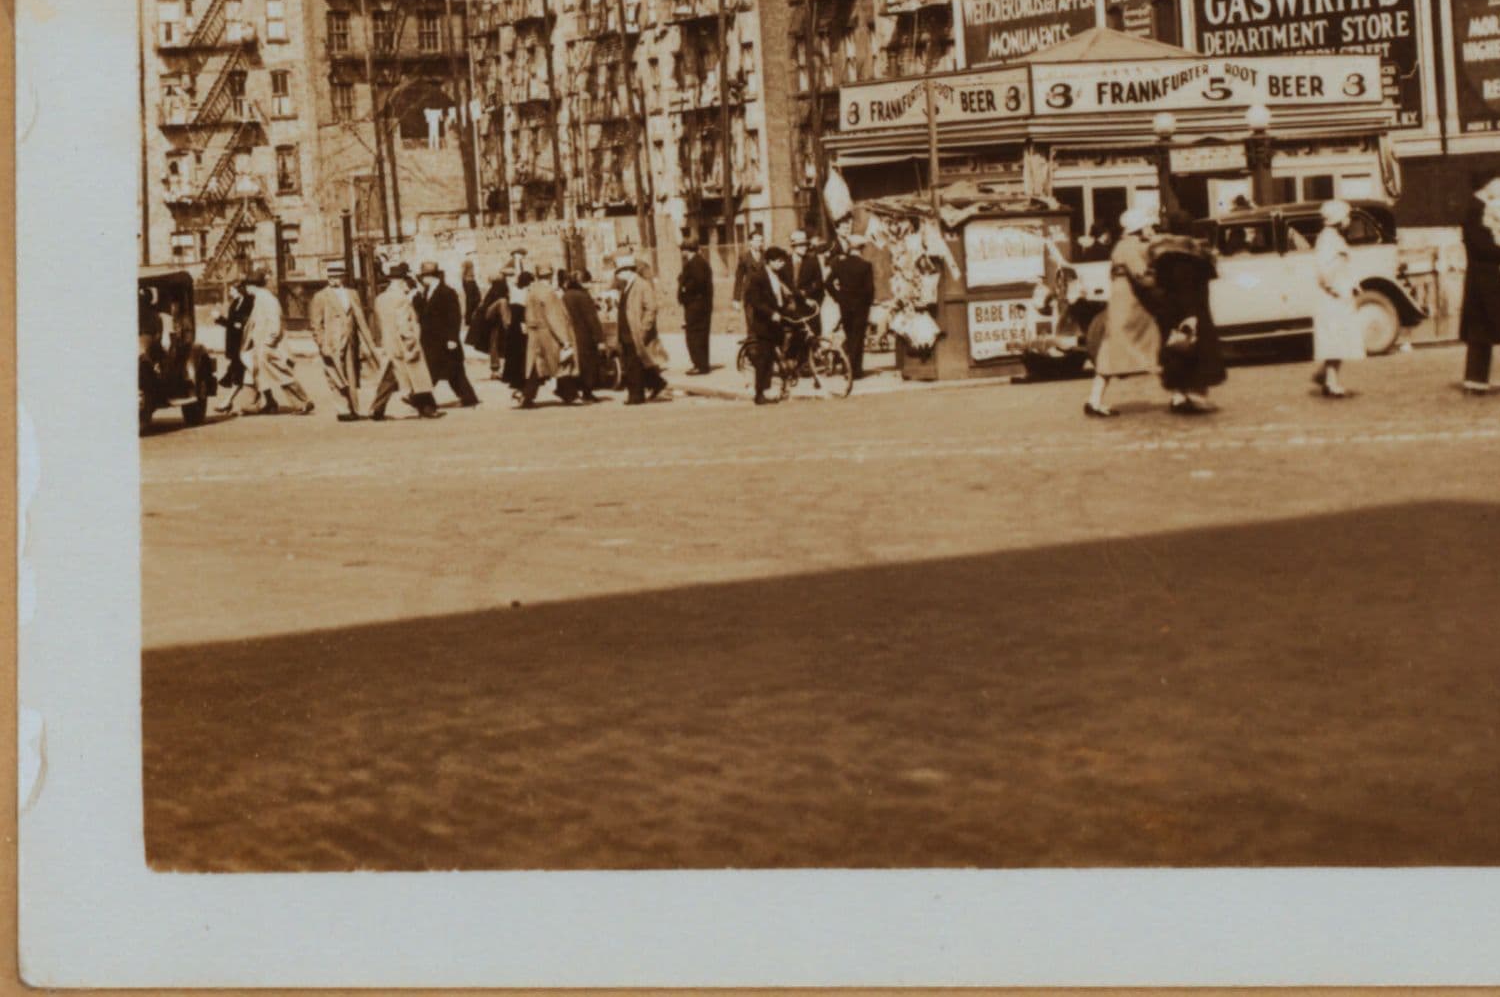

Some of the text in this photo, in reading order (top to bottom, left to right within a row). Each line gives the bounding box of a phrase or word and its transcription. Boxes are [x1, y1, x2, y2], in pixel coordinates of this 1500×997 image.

[988, 22, 1071, 60] MONUMENTS
[1203, 10, 1410, 56] DEPARTMENT STORE
[846, 101, 860, 125] 3
[959, 89, 997, 114] BEER
[1004, 85, 1021, 112] 3
[1044, 82, 1074, 109] 3
[1096, 63, 1209, 106] FRANKFURTER
[1202, 77, 1233, 101] 5
[1224, 63, 1259, 88] ROOT
[1267, 74, 1325, 99] BEER
[1342, 72, 1367, 97] 3
[974, 305, 1004, 323] BABE
